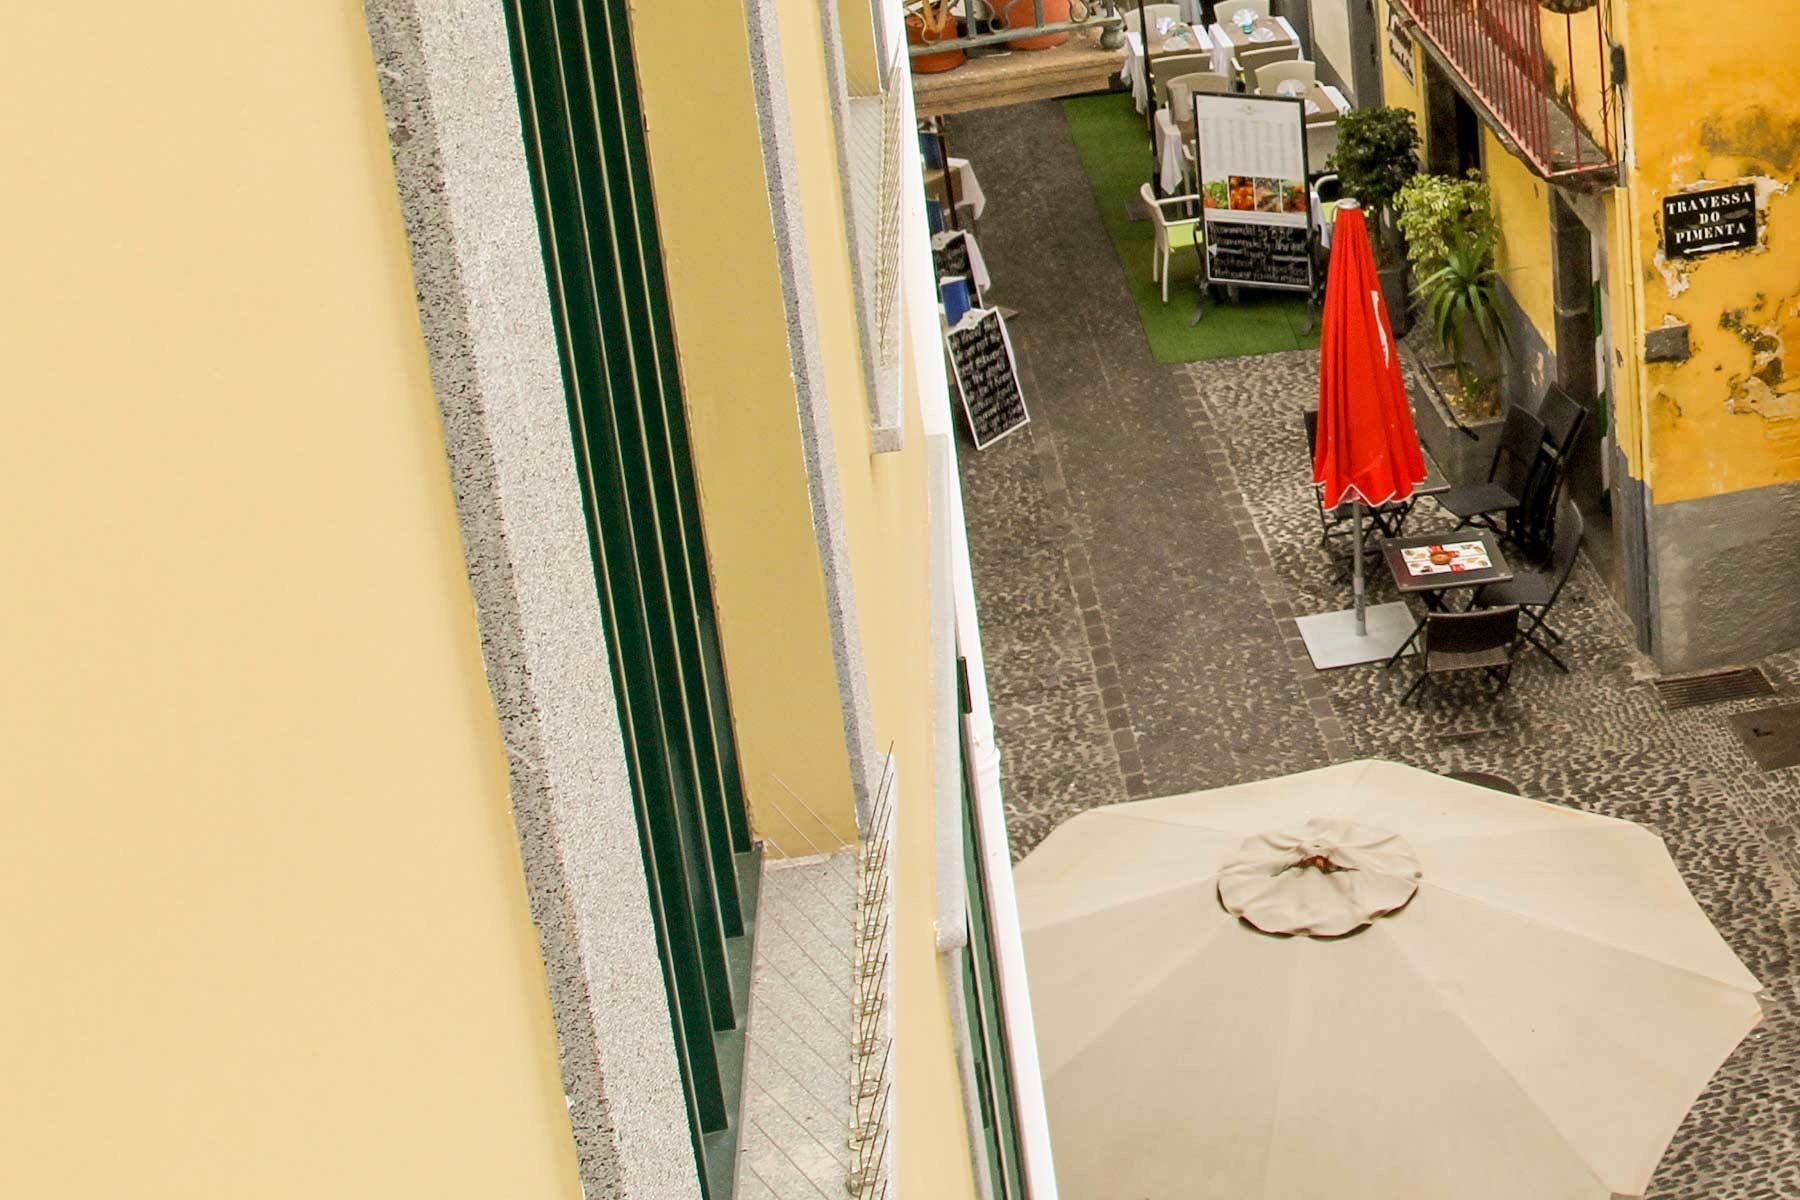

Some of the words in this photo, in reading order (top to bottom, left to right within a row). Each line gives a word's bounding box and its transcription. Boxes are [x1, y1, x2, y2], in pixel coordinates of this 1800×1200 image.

[1666, 191, 1752, 215] TRAVESSA
[1699, 211, 1720, 225] DO
[1675, 222, 1746, 244] PIMENTA
